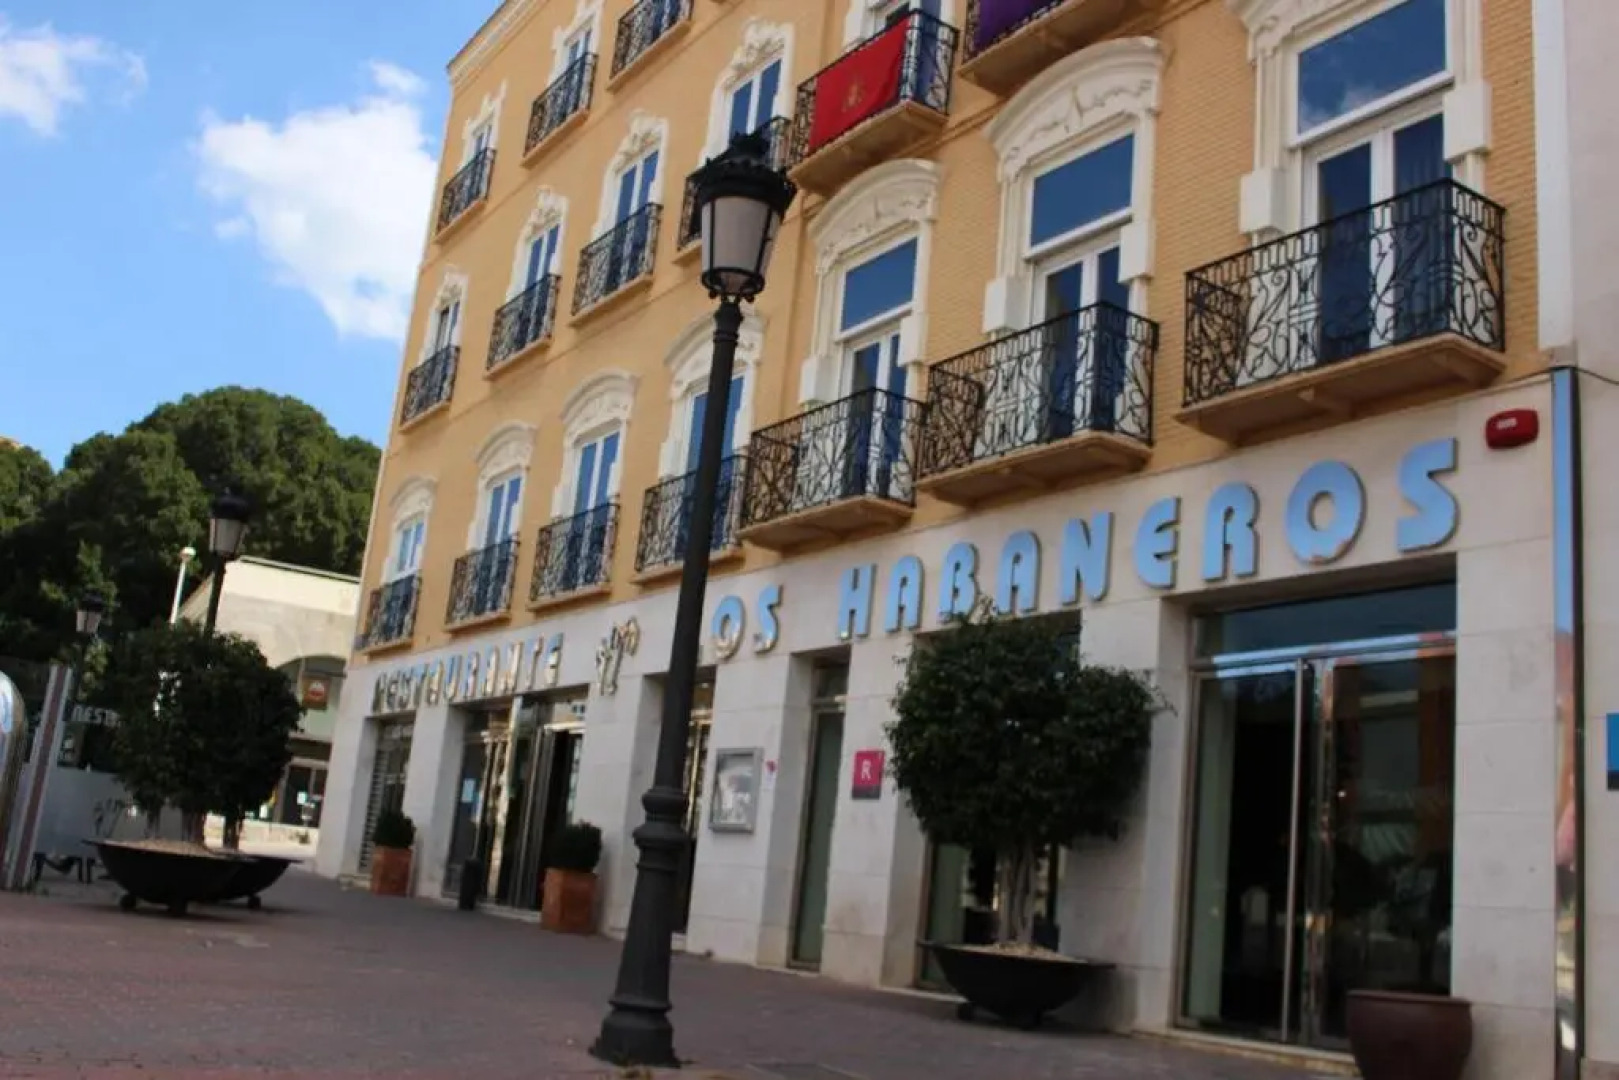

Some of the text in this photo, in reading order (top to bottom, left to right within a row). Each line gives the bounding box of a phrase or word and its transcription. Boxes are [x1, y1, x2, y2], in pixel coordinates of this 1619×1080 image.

[372, 437, 1461, 714] RESTAURANTE OS HABANEROS
[861, 759, 872, 781] R
